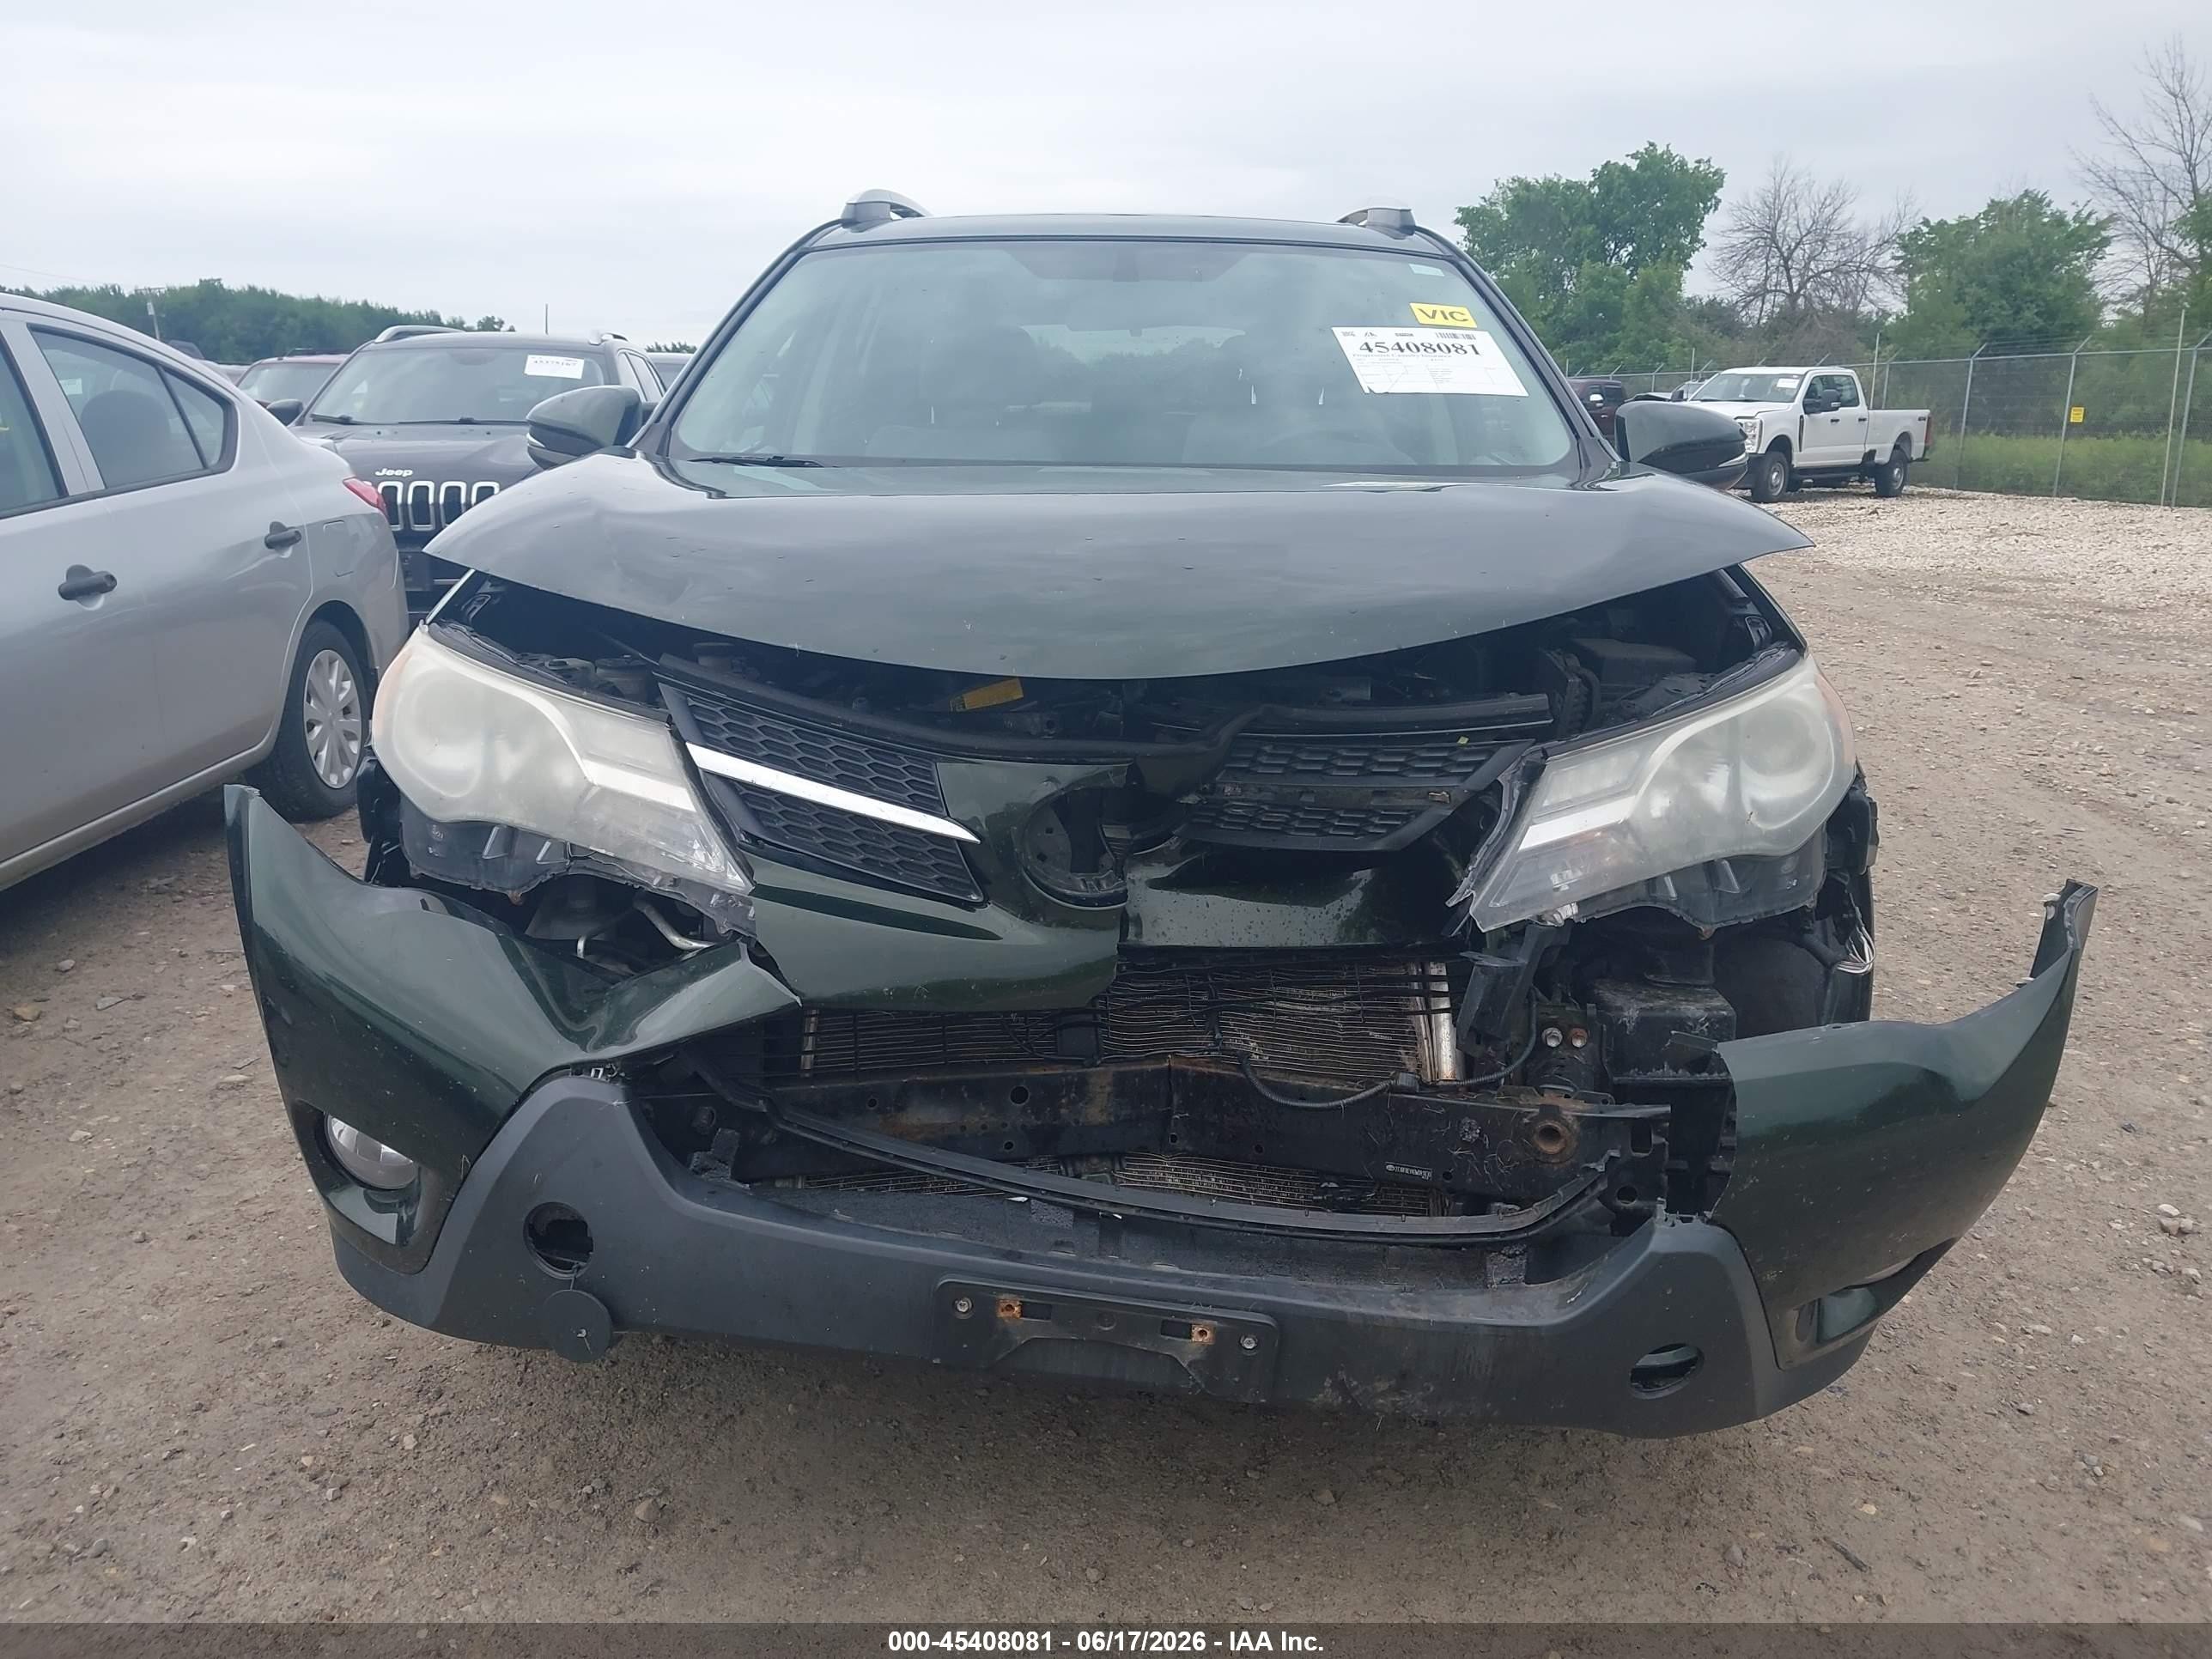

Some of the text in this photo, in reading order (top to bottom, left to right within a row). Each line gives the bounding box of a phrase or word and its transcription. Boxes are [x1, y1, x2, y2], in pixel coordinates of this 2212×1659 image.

[1416, 308, 1469, 322] VIC
[1359, 341, 1480, 356] 45408081
[374, 467, 414, 477] Jeep
